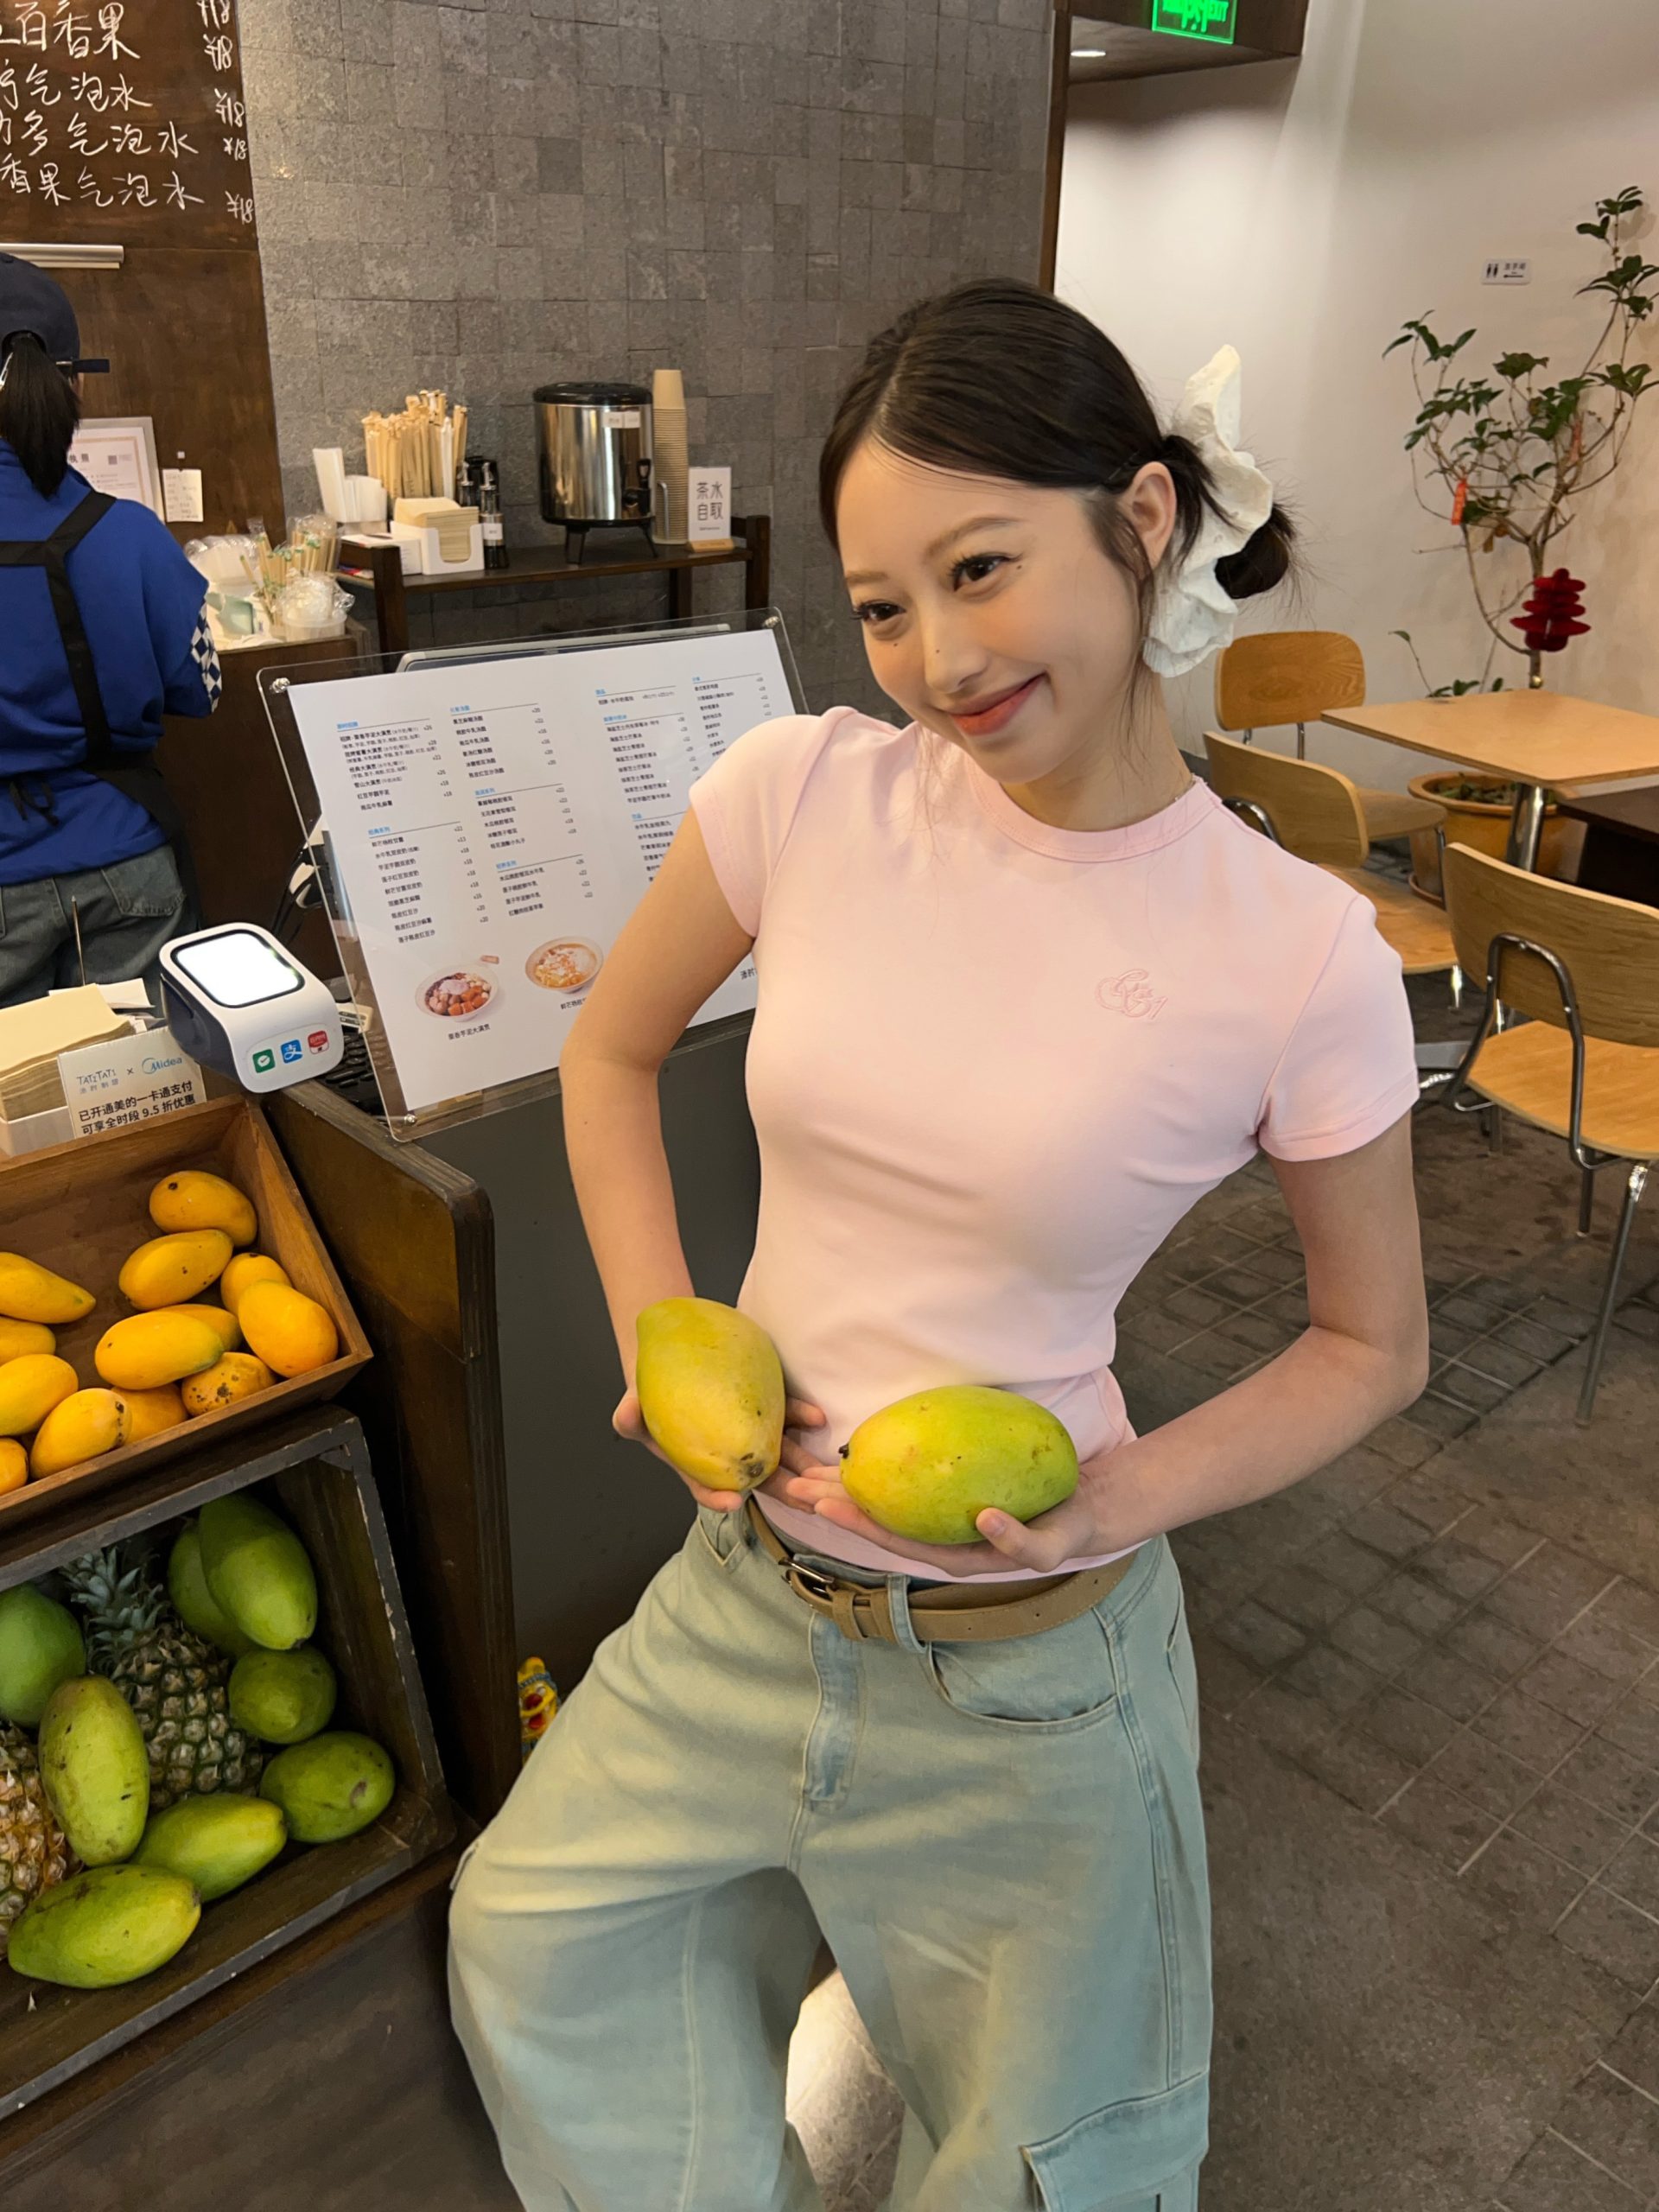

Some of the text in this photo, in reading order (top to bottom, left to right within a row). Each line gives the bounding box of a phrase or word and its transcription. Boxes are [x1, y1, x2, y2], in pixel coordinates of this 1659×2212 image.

[696, 481, 723, 499] 茶水
[697, 502, 723, 520] 自取
[79, 1080, 193, 1122] 已开通美的一卡通支付
[81, 1094, 196, 1135] 可享全时段 9.5 折优惠
